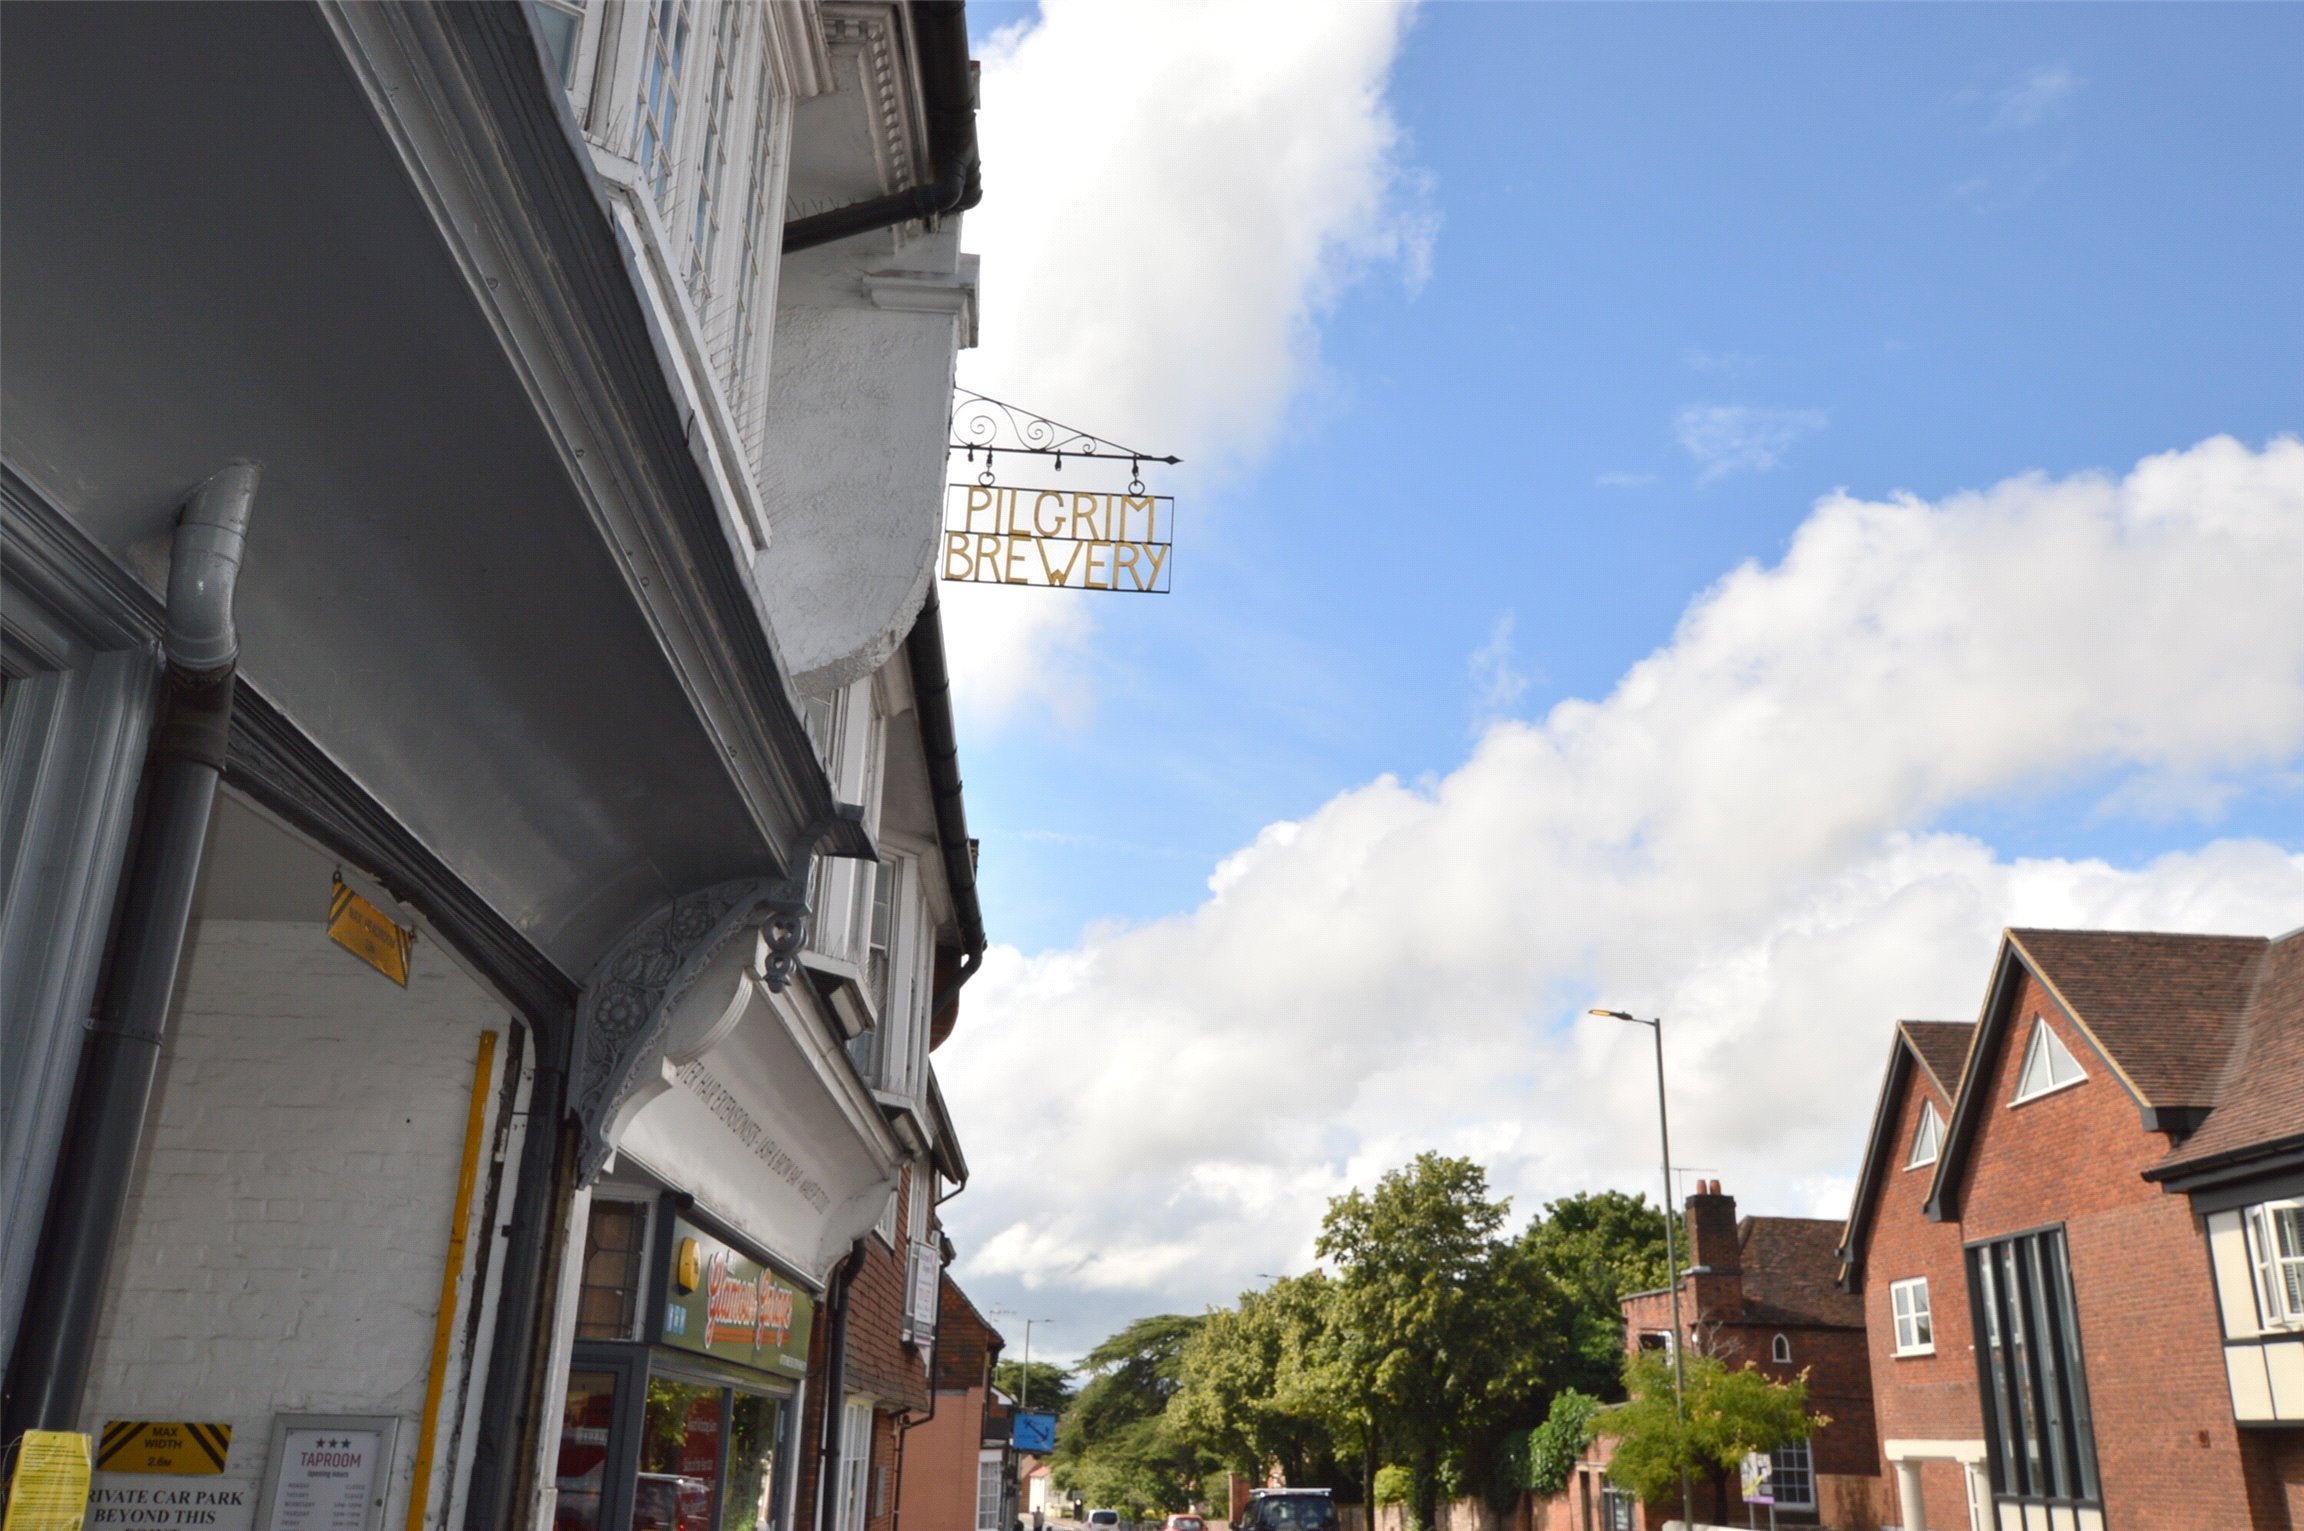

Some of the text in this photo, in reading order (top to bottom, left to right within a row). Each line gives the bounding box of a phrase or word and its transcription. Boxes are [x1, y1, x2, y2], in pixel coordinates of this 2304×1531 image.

[965, 485, 1156, 544] PILGRIM
[945, 532, 1169, 592] BREWERY
[152, 1427, 178, 1437] MAX
[144, 1439, 183, 1449] WIDTH
[301, 1452, 362, 1468] TAPROOM
[153, 1490, 191, 1505] CAR
[195, 1491, 245, 1506] PARK
[94, 1508, 217, 1525] BEYOND THIS
